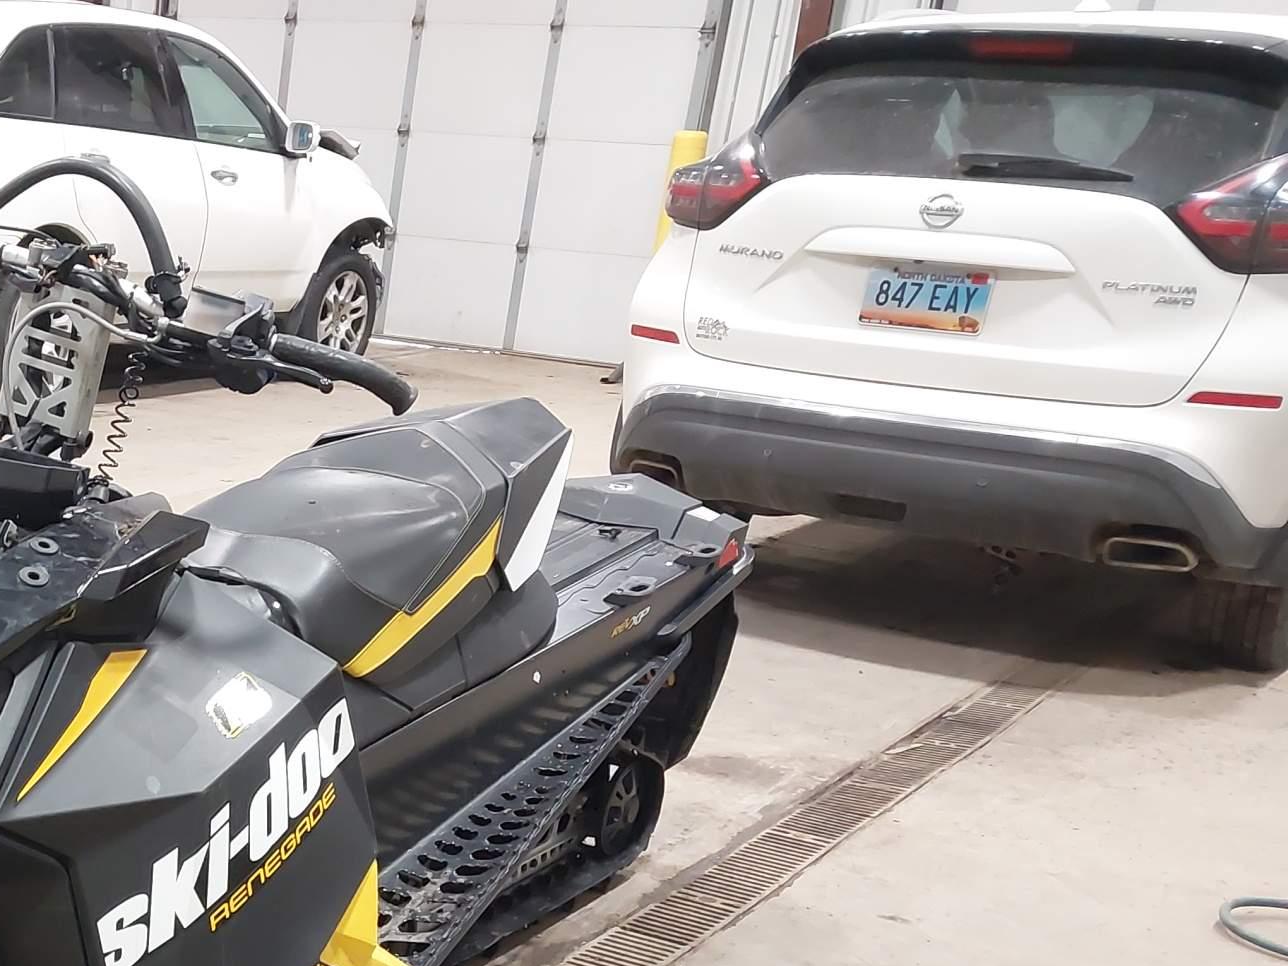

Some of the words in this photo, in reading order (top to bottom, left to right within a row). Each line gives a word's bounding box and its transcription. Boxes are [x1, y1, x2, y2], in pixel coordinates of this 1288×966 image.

[719, 244, 784, 260] MURANO
[1102, 280, 1198, 294] PLATINUM
[875, 279, 924, 309] 847
[928, 284, 979, 314] EAY
[1154, 295, 1195, 306] AWD
[210, 783, 337, 932] RENEGADE
